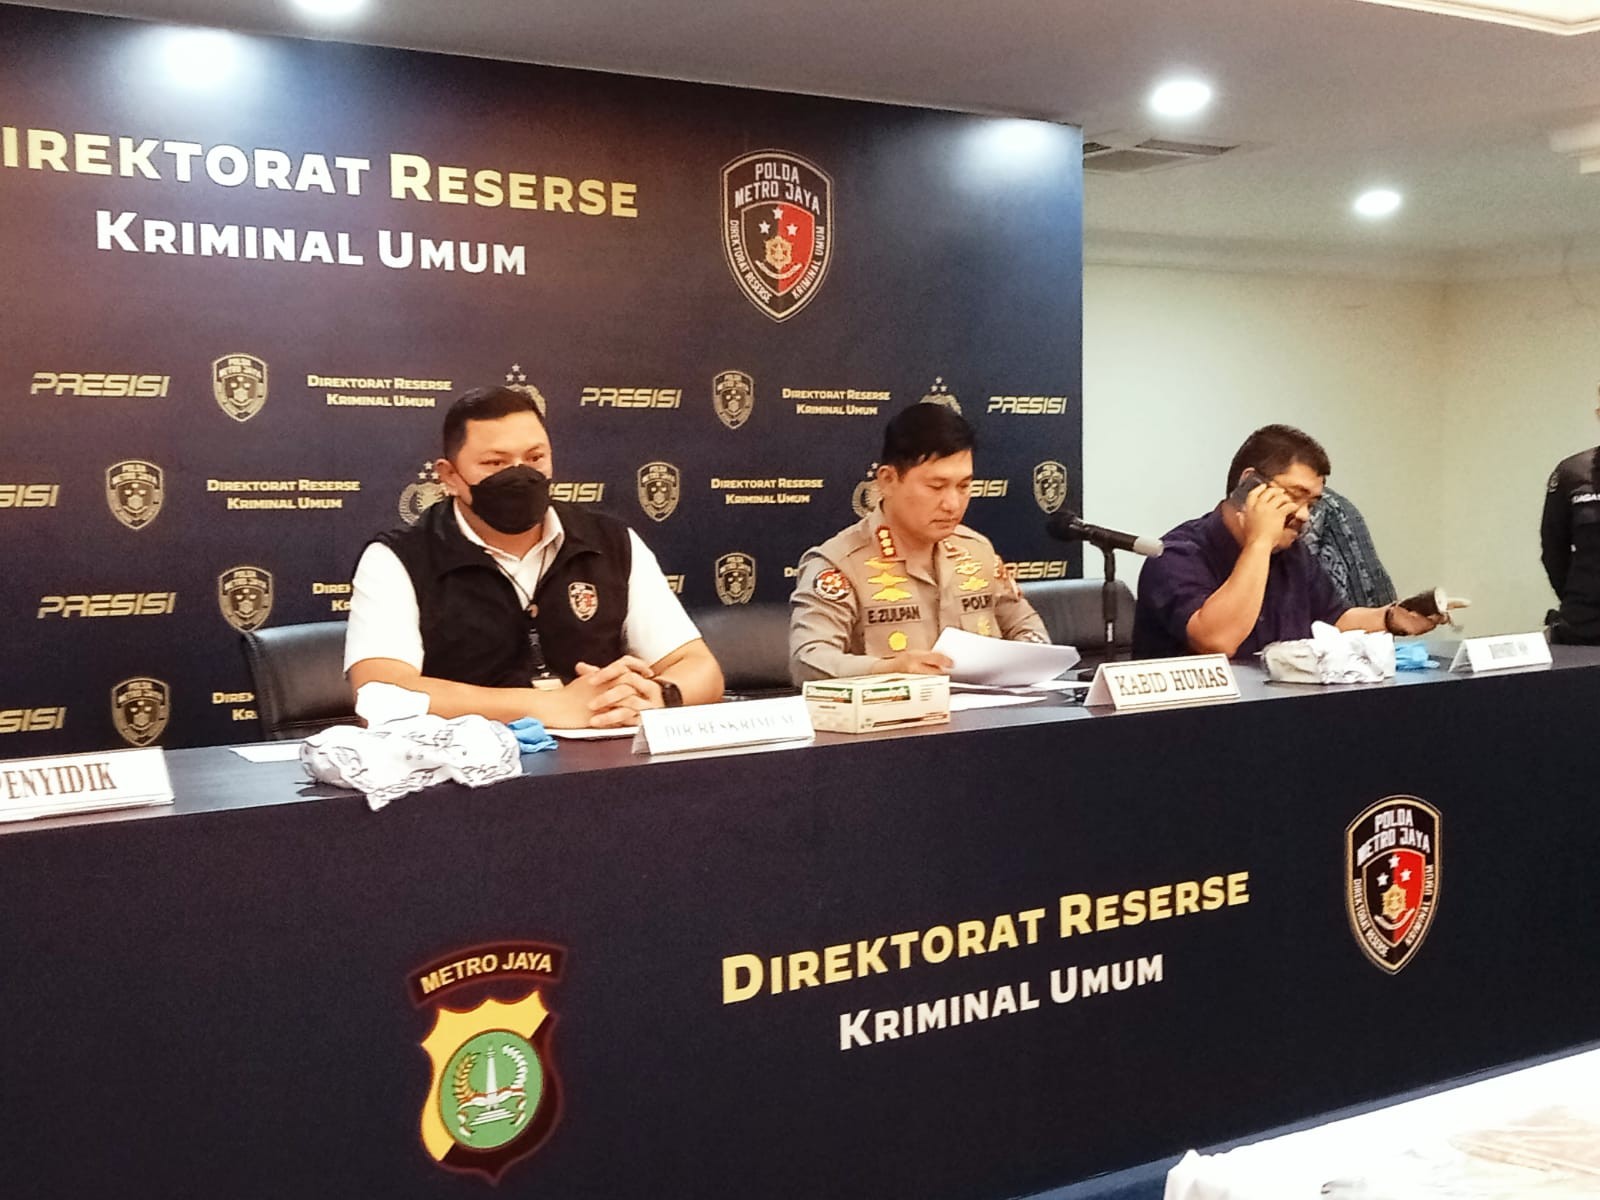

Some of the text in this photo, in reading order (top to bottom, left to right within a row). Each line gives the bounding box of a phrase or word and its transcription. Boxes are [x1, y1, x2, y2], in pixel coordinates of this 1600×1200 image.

[390, 153, 638, 218] RESERSE
[755, 162, 799, 184] POLDA
[734, 181, 820, 215] METRO JAYA
[96, 210, 527, 276] KRIMINAL UMUM
[30, 372, 170, 397] PRESISI
[307, 374, 452, 391] DIREKTORAT RESERSE
[782, 388, 846, 399] DIREKTORAT
[326, 392, 435, 408] KRIMINAL UMUM
[580, 387, 682, 408] PRESISI
[987, 396, 1067, 415] PRESISI
[207, 479, 360, 492] DIREKTORAT RESERSE
[710, 478, 776, 489] DIREKTORAT
[227, 497, 343, 510] KRIMINAL UMUM
[37, 592, 177, 619] PRESISI
[1115, 666, 1229, 696] KABID HUMAS
[1374, 808, 1414, 833] POLDA
[1357, 828, 1431, 866] METRO JAYA
[722, 871, 1250, 1005] DIREKTORAT RESERSE
[420, 952, 553, 994] METRO JAYA
[840, 954, 1164, 1051] KRIMINAL UMUM
